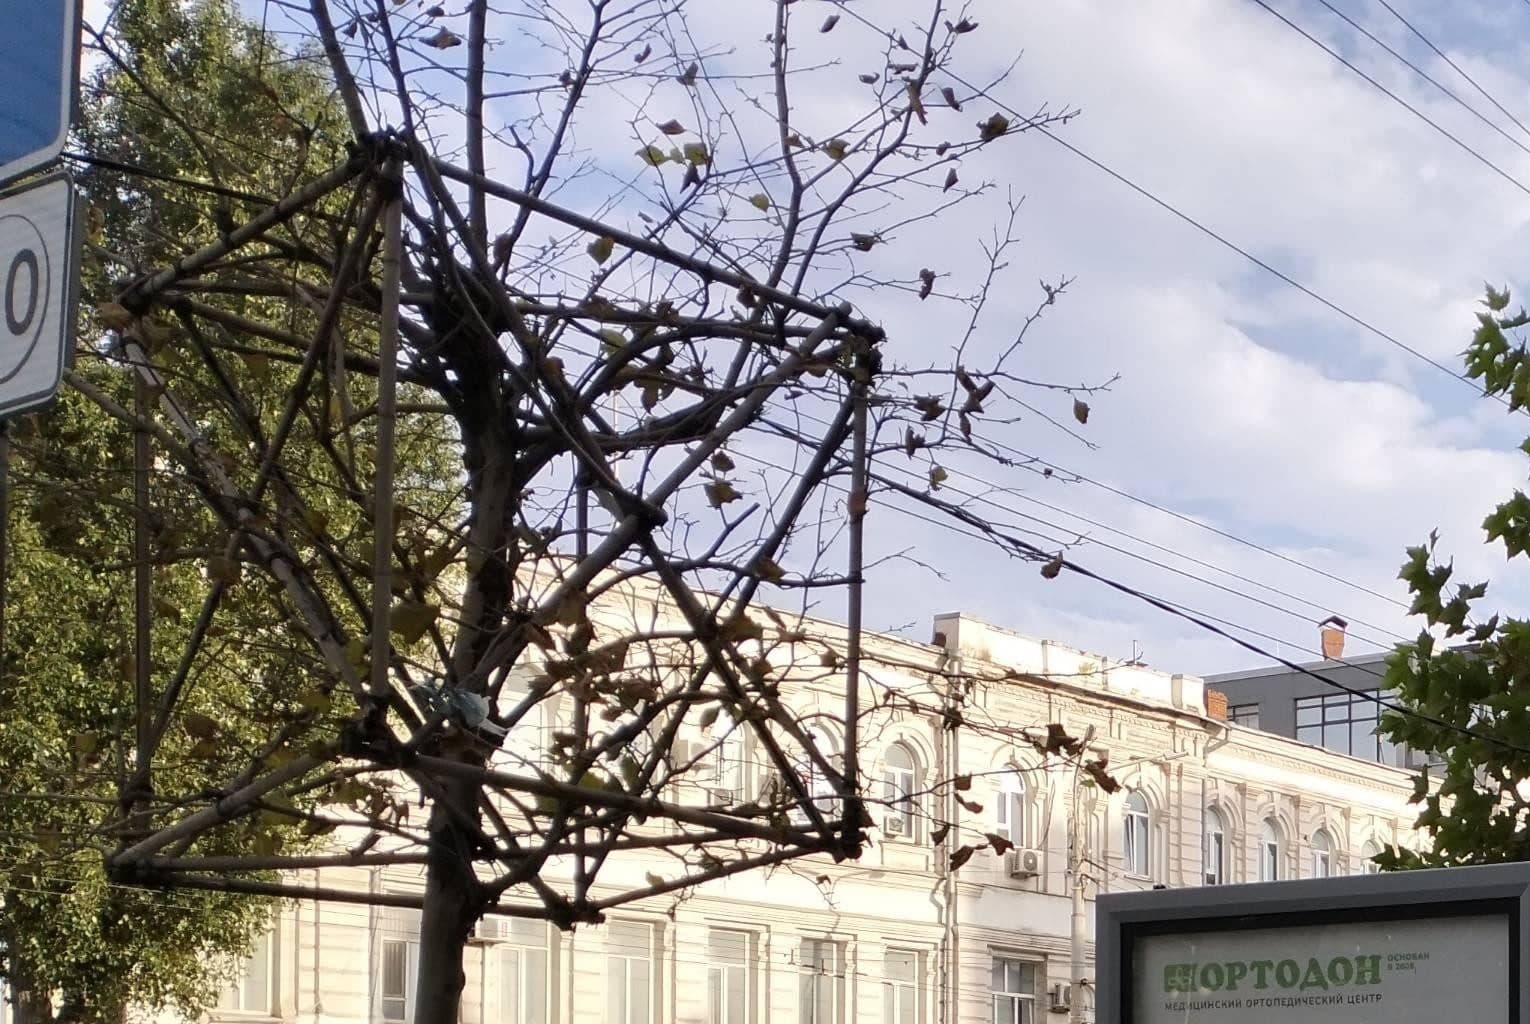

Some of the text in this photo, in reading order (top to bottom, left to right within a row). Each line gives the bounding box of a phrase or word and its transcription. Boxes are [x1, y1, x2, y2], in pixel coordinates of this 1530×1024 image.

[1200, 955, 1382, 991] ОРТОДОН
[1246, 995, 1343, 1008] ОРТОПЕДИЧЕСКИЙ
[1347, 994, 1382, 1004] ЦЕНТР
